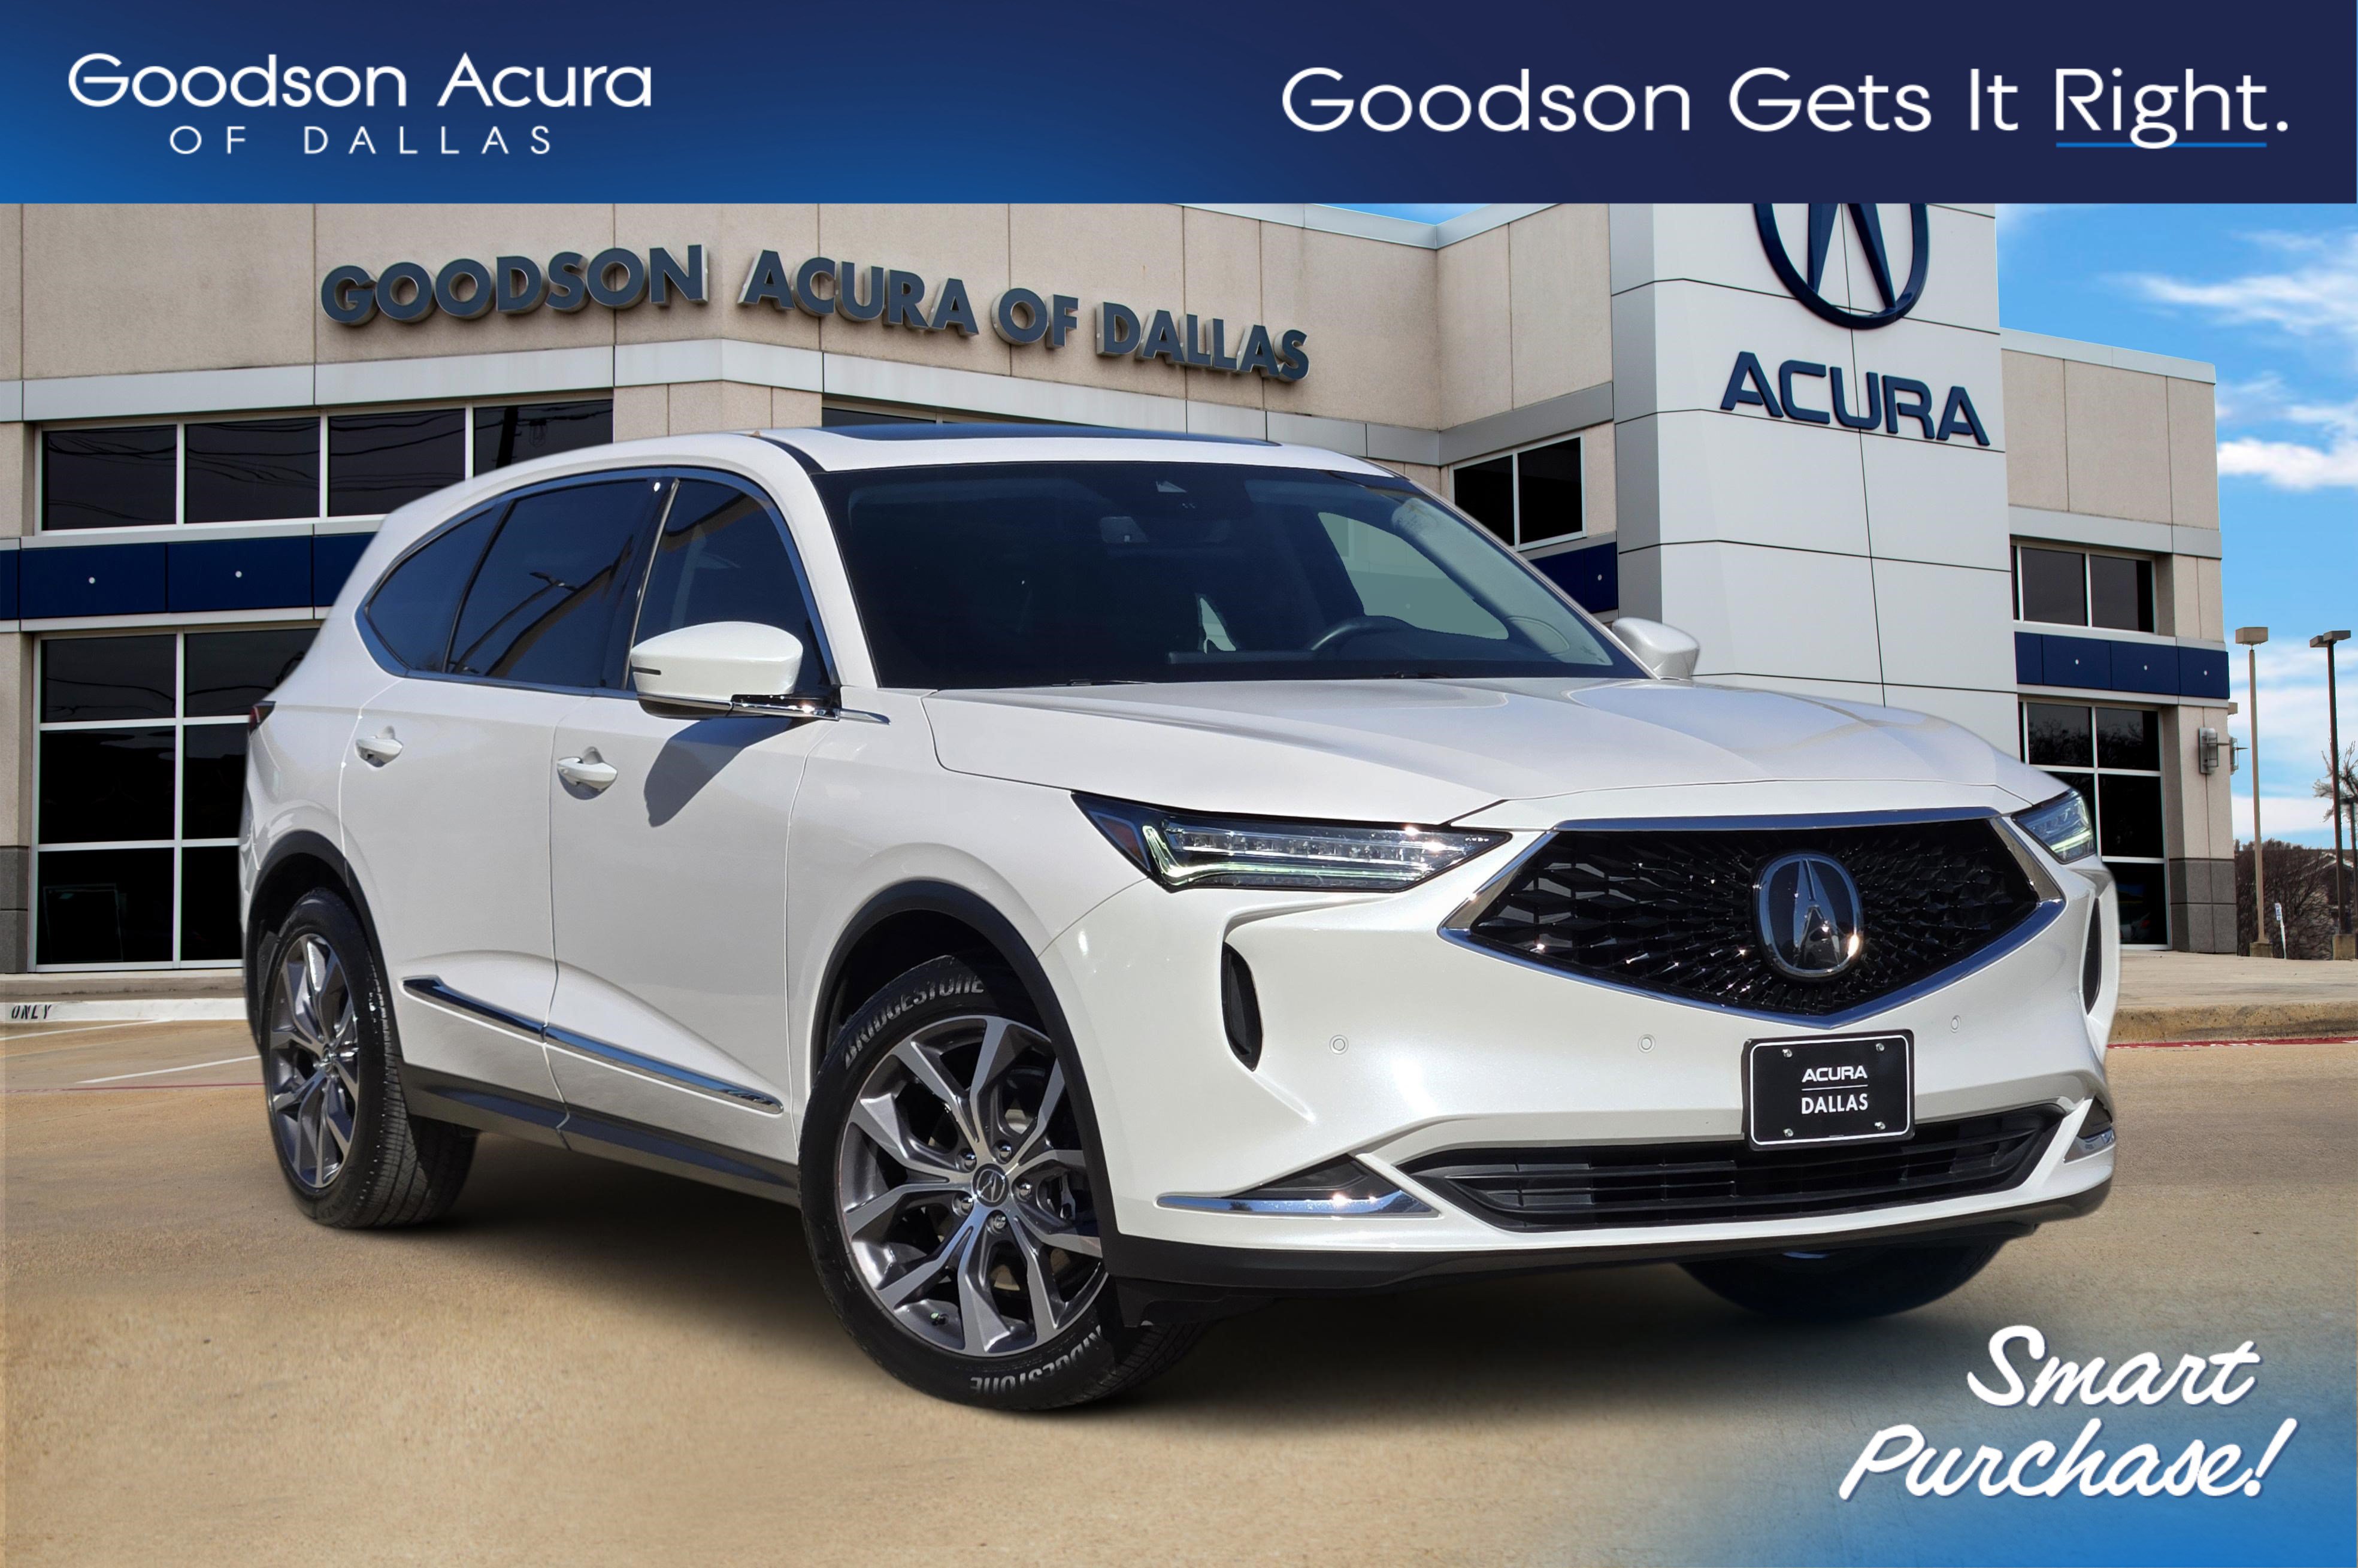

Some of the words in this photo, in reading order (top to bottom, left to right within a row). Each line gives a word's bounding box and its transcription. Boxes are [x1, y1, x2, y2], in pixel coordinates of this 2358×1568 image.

[320, 244, 708, 325] GOODSON
[737, 249, 979, 337] ACURA
[991, 287, 1078, 349] OF
[1096, 302, 1310, 382] DALLAS
[1720, 351, 1990, 446] ACURA
[11, 1004, 52, 1019] ONLY
[1802, 1065, 1867, 1083] ACURA
[1801, 1093, 1869, 1115] DALLAS
